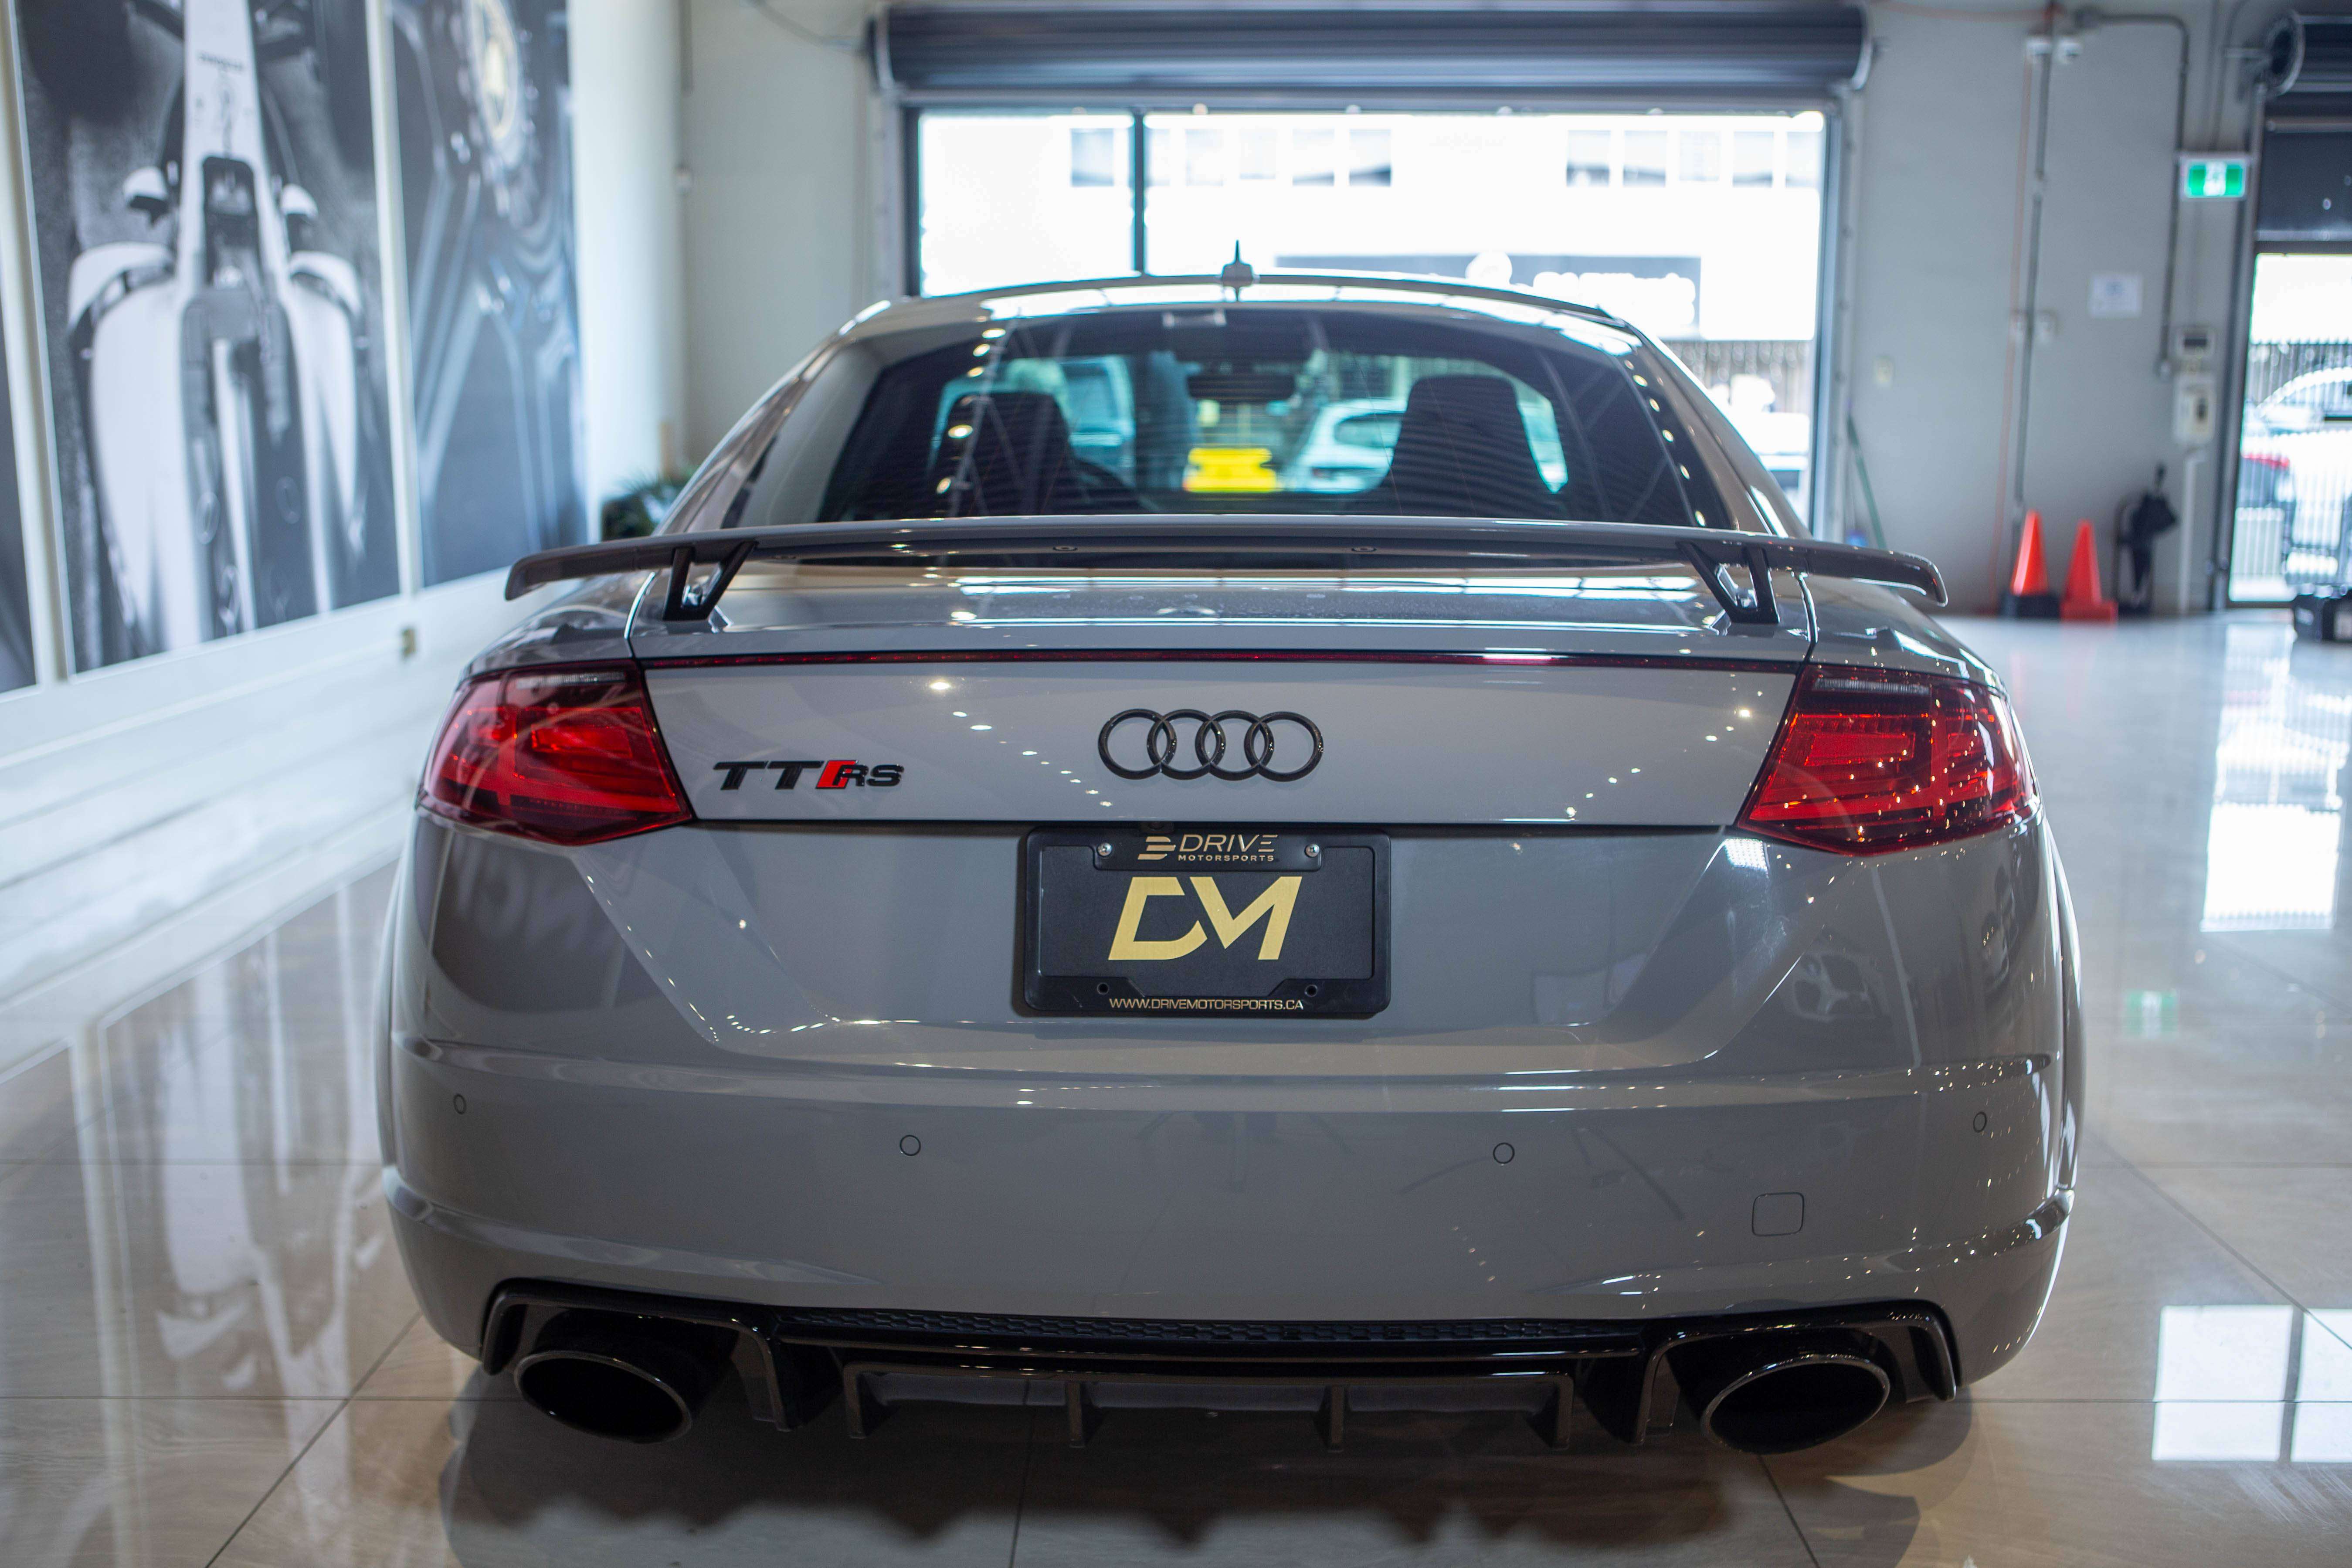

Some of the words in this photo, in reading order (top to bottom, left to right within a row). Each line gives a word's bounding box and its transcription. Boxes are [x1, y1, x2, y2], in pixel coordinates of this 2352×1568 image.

[1179, 834, 1278, 852] DRIVE
[1108, 876, 1303, 960] DM
[1109, 998, 1304, 1010] WWW.DRIVEMOTORSPORTS.CA
